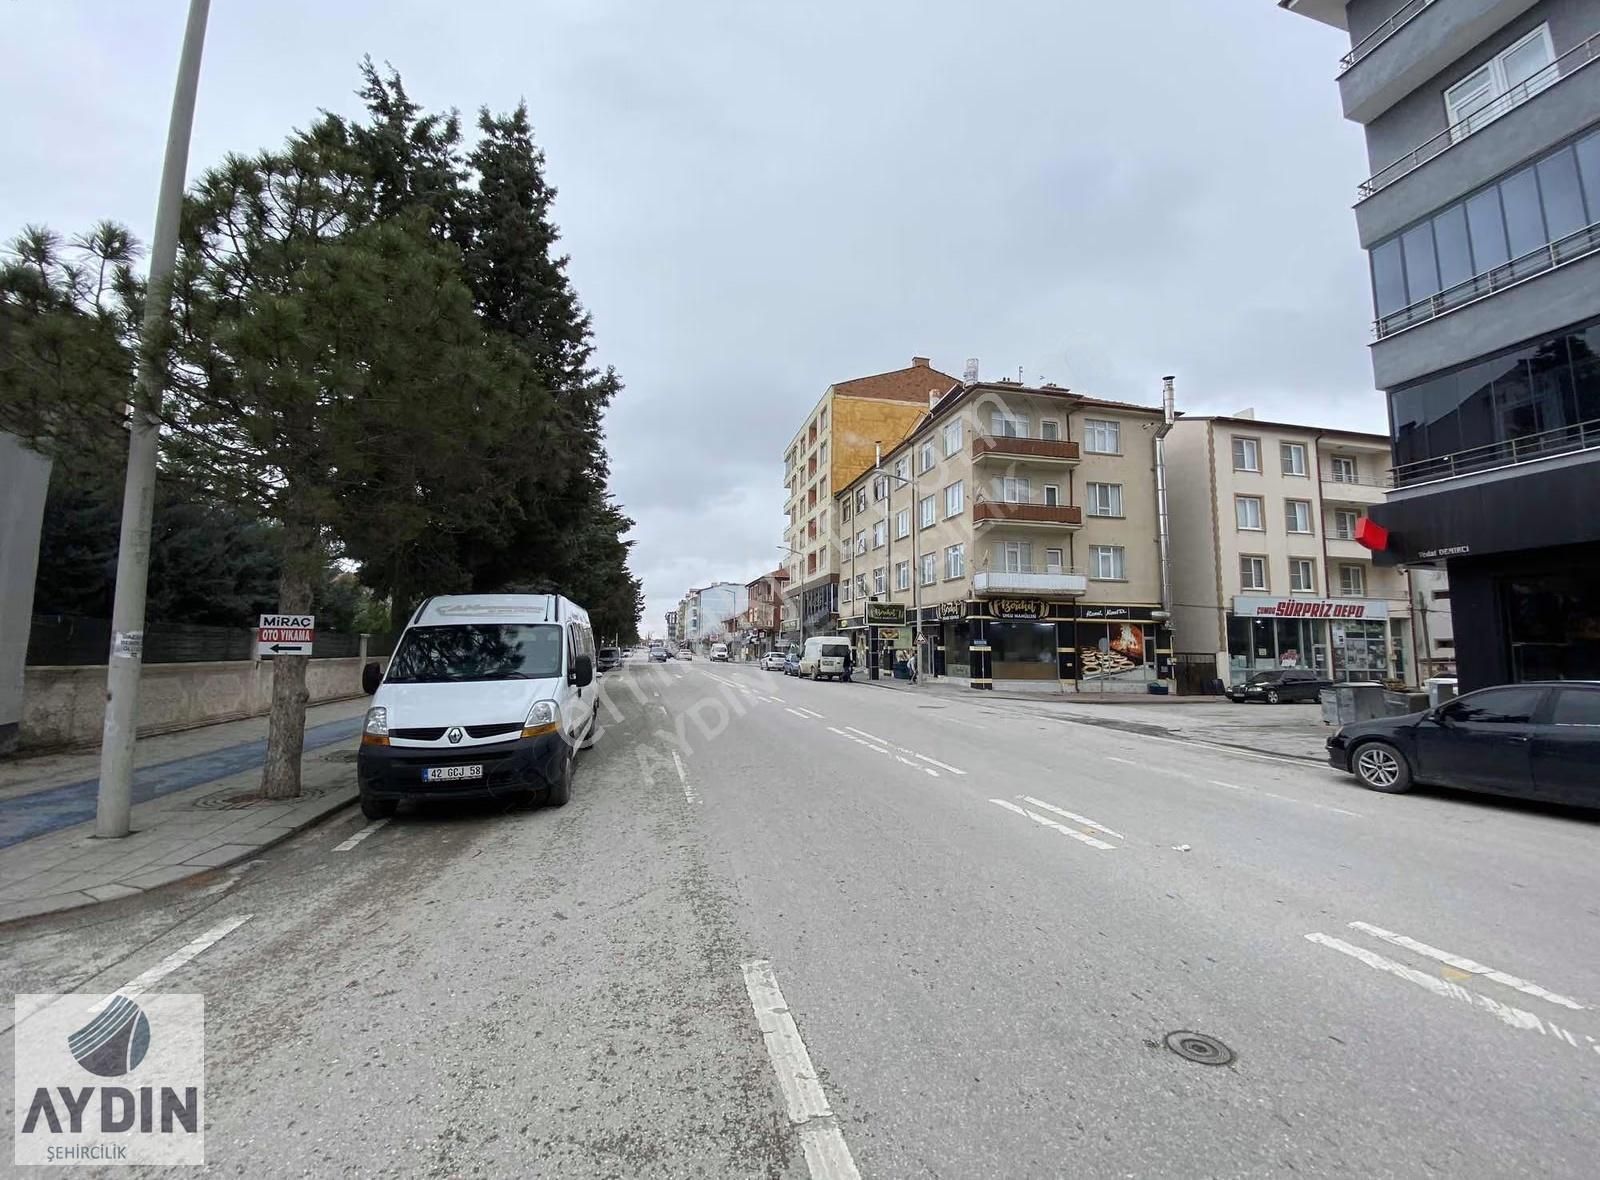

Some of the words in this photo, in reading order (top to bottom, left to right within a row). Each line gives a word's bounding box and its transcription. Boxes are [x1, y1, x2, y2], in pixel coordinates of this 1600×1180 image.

[1276, 599, 1333, 617] SÜRPRİZ
[1333, 604, 1365, 618] DEPO
[262, 629, 278, 641] OTO
[281, 629, 311, 641] YIKAMA
[431, 769, 442, 778] 42
[447, 767, 464, 776] GCJ
[470, 766, 481, 775] 58
